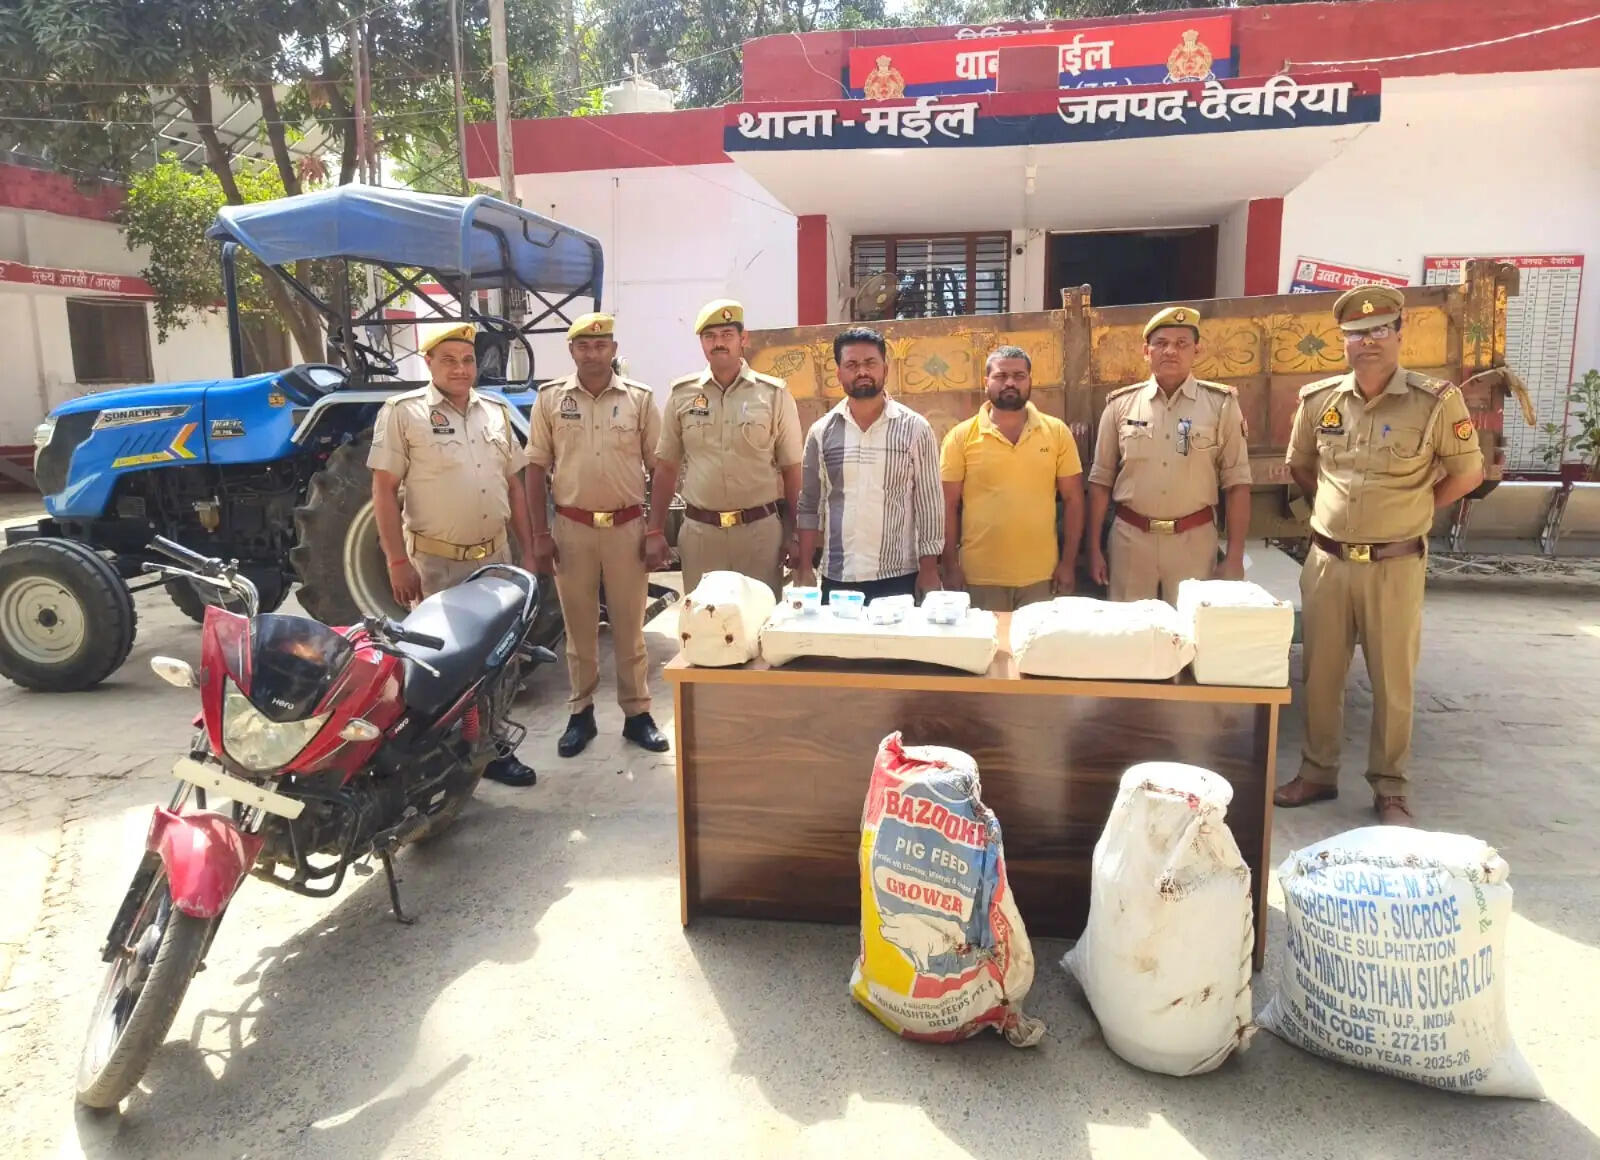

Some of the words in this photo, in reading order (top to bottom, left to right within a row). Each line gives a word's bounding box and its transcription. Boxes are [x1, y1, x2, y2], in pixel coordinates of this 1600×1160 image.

[738, 108, 837, 139] थाना
[861, 95, 979, 144] मईल
[104, 408, 162, 422] SONALIKA
[271, 697, 295, 710] Hero
[895, 837, 926, 860] PIG
[931, 847, 969, 875] FEED
[886, 877, 963, 915] GROWER
[1391, 894, 1461, 940] SUCROSE
[1302, 915, 1352, 954] DOUBLE
[1357, 937, 1456, 963] SULPHITATION
[1312, 941, 1413, 1010] HINDUSTHAN
[1417, 957, 1471, 1010] SUGAR
[928, 1015, 959, 1028] DELHI
[941, 999, 970, 1017] FEEDS
[1304, 995, 1327, 1026] PIN
[1330, 1014, 1377, 1044] CODE
[1391, 1032, 1447, 1052] 272151
[1423, 1010, 1456, 1029] INDIA
[1337, 1038, 1373, 1057] CROP
[1376, 1048, 1412, 1067] YEAR
[1424, 1049, 1471, 1069] 2025-26
[1421, 1074, 1457, 1089] FROM
